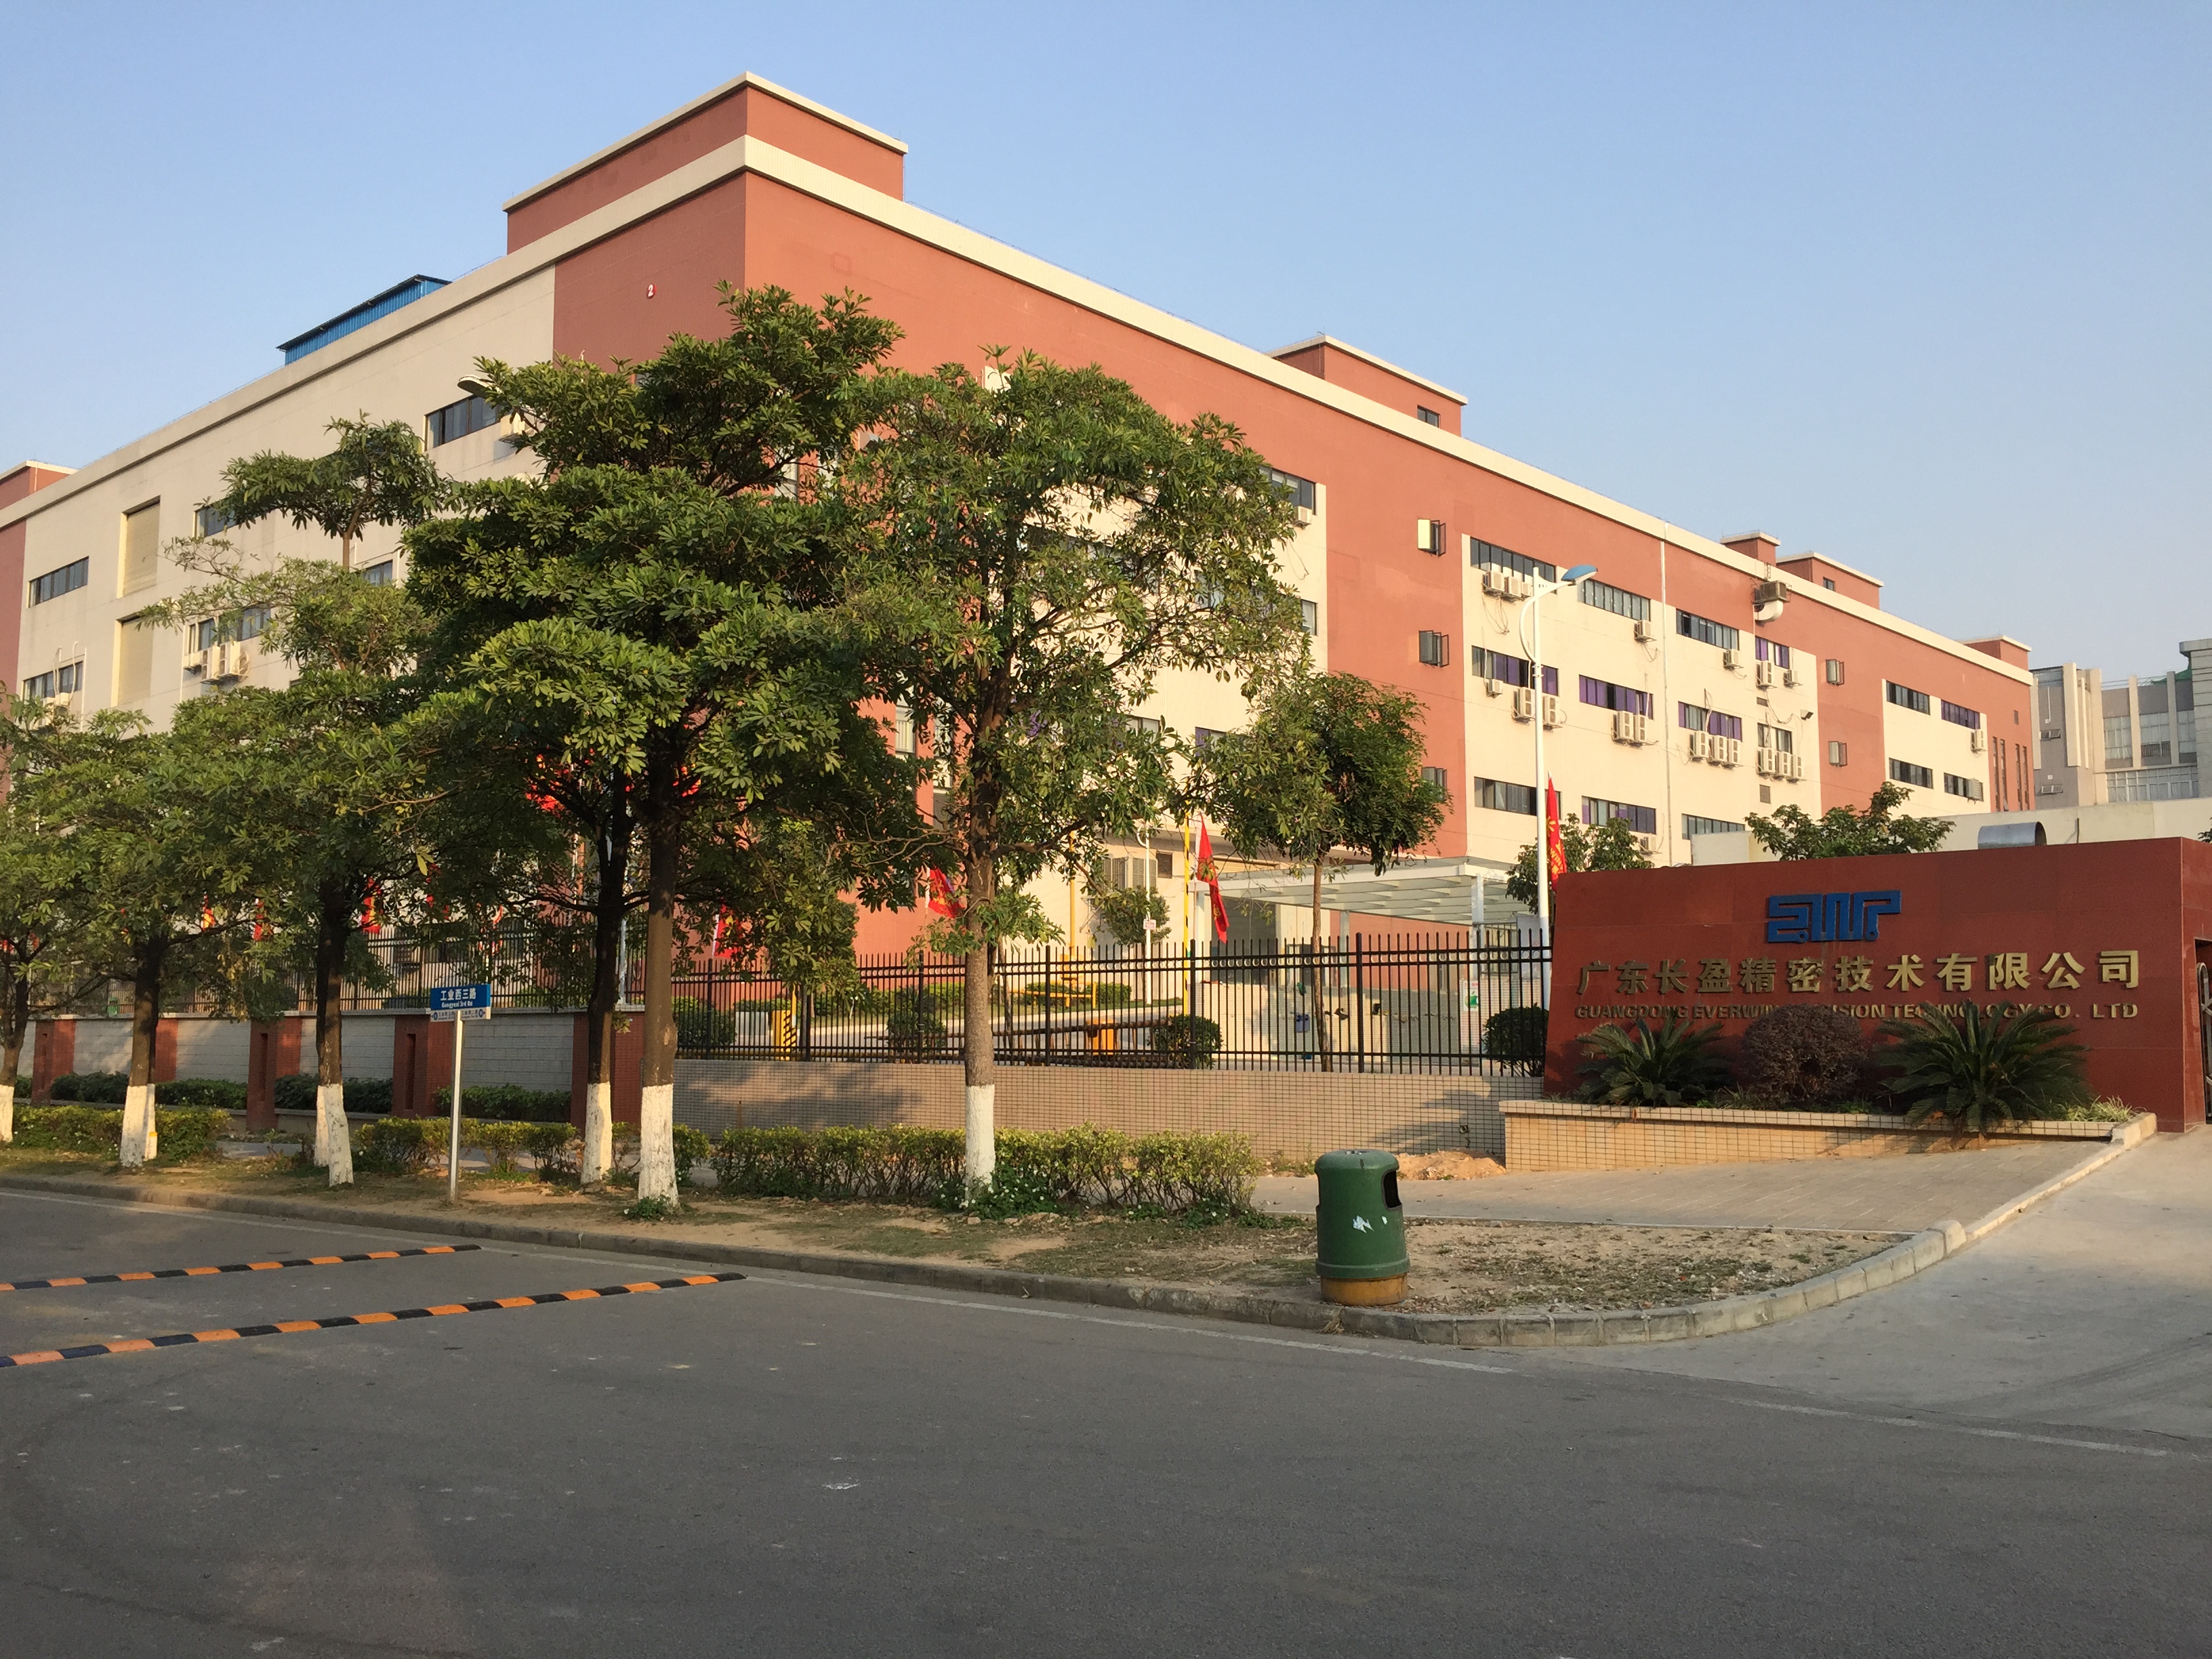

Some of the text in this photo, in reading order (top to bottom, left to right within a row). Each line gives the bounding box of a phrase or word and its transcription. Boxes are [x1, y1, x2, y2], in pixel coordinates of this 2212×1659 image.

[648, 284, 654, 297] 2
[1576, 950, 2139, 994] 广东长盈精密技术有限公司
[441, 987, 476, 1000] 工业西三路
[1576, 1004, 1688, 1018] GUANGDONG
[1891, 1003, 2033, 1019] TECNOGY
[2093, 1003, 2138, 1019] LTD
